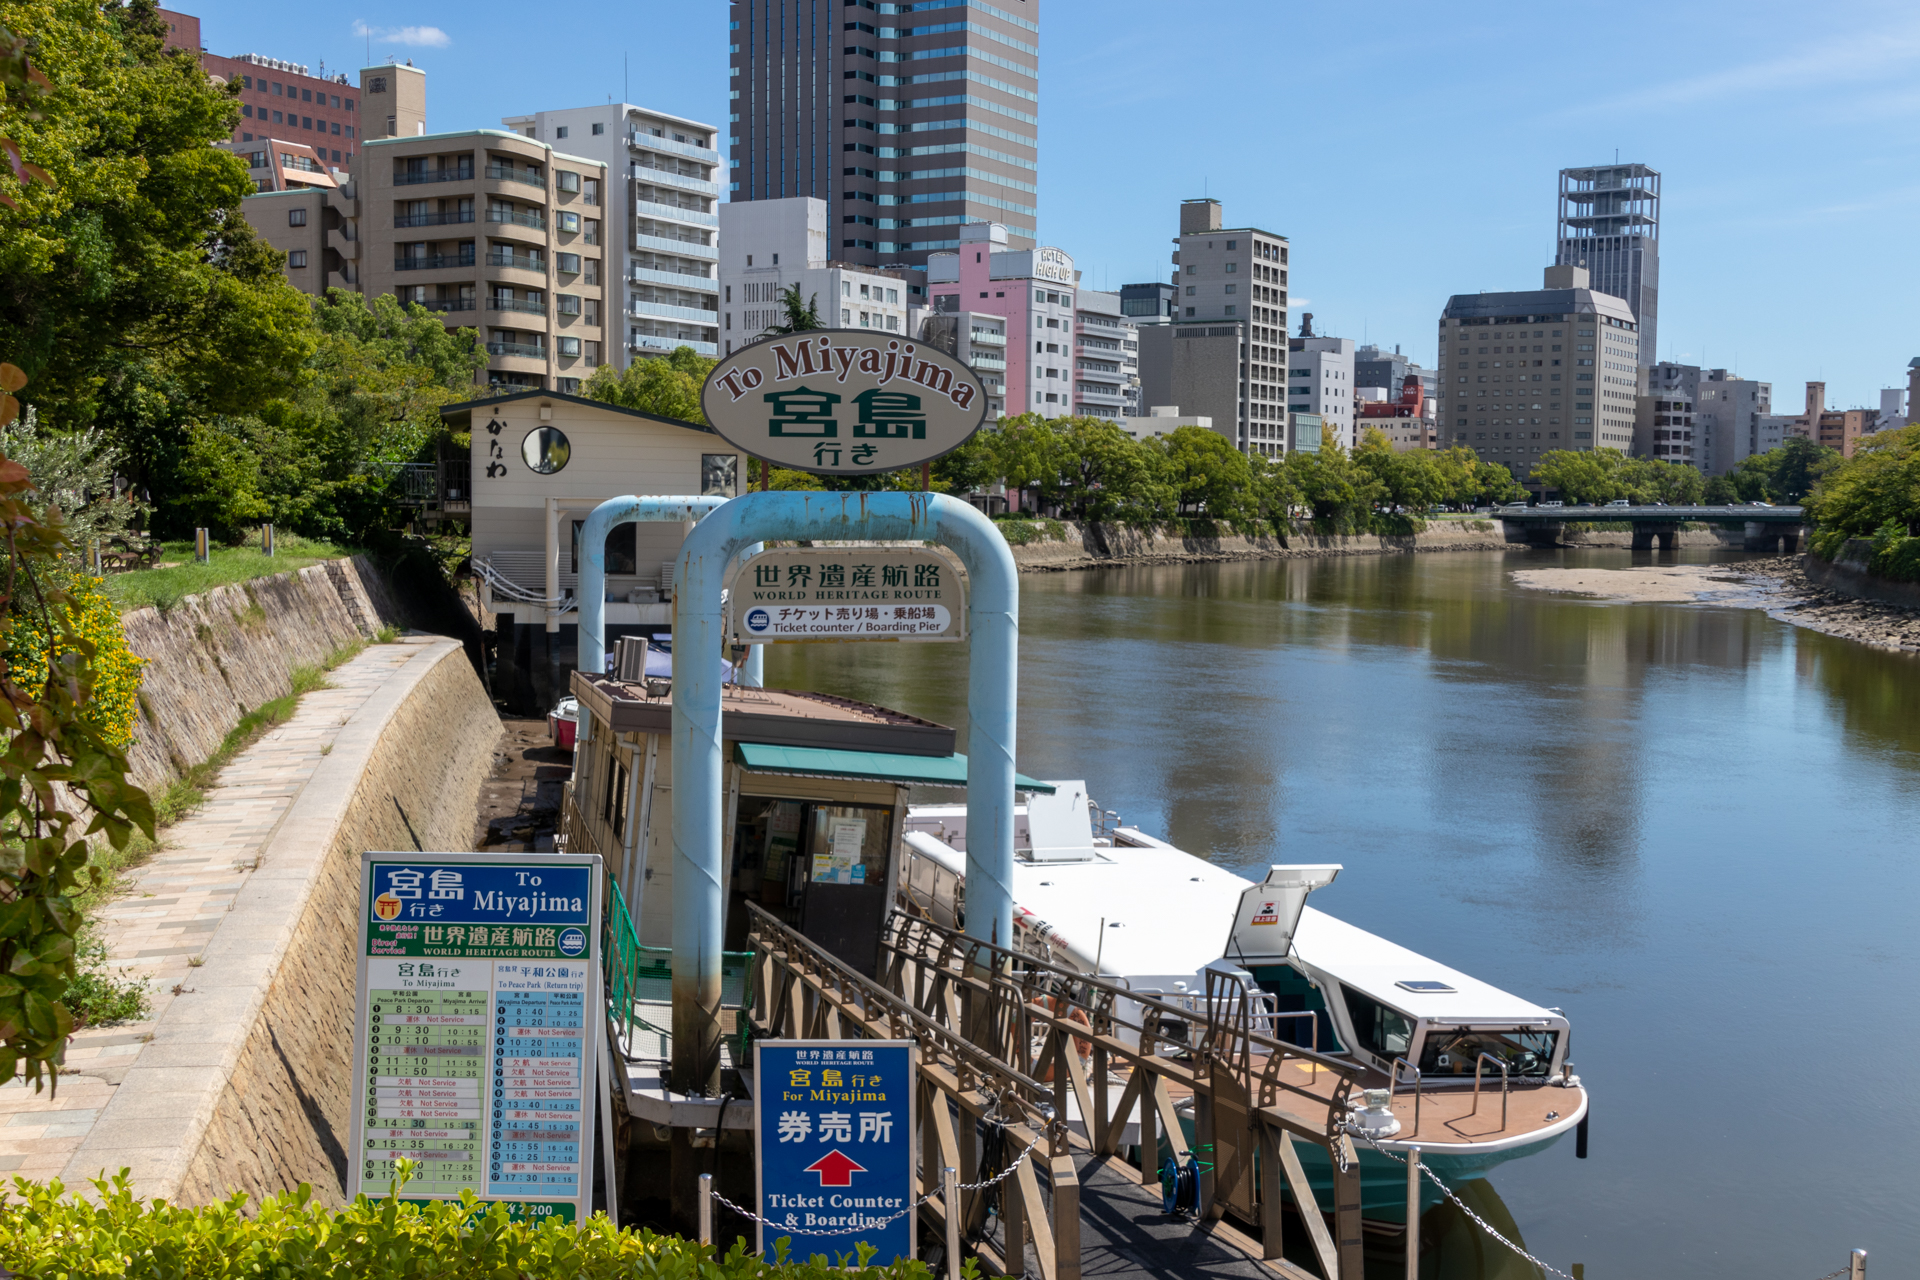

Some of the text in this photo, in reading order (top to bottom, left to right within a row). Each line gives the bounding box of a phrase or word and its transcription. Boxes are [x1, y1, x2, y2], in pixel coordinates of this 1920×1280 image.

[1042, 250, 1065, 264] HOTEL
[1036, 262, 1071, 281] HIGH UP
[715, 336, 976, 411] To Miyajima
[764, 385, 926, 439] 宮島
[486, 418, 508, 478] かなわ
[813, 442, 878, 466] 行き
[754, 563, 940, 588] 世界遺産航路
[753, 590, 941, 600] WORLD HERITAGE ROUTE
[779, 607, 935, 620] チケット売り場・乗船場
[773, 622, 941, 633] Ticket counter / Boarding Pier
[388, 868, 464, 900] 宮島
[515, 872, 542, 886] To
[410, 903, 445, 917] 行き
[473, 891, 583, 918] Miyajima
[423, 926, 556, 947] 世界遺産航路
[416, 980, 455, 988] Miyajima
[569, 983, 583, 991] trip)
[396, 1026, 429, 1034] 9:30
[387, 1036, 429, 1044] 10:10
[386, 1057, 428, 1065] 11:10
[796, 1050, 874, 1060] 世界遺産航路
[386, 1067, 427, 1075] 11:50
[783, 1090, 886, 1104] For Miyajima
[777, 1111, 893, 1143] 券売所
[383, 1140, 424, 1148] 15:35
[768, 1194, 902, 1208] Ticket Counter
[785, 1213, 886, 1230] & Boarding
